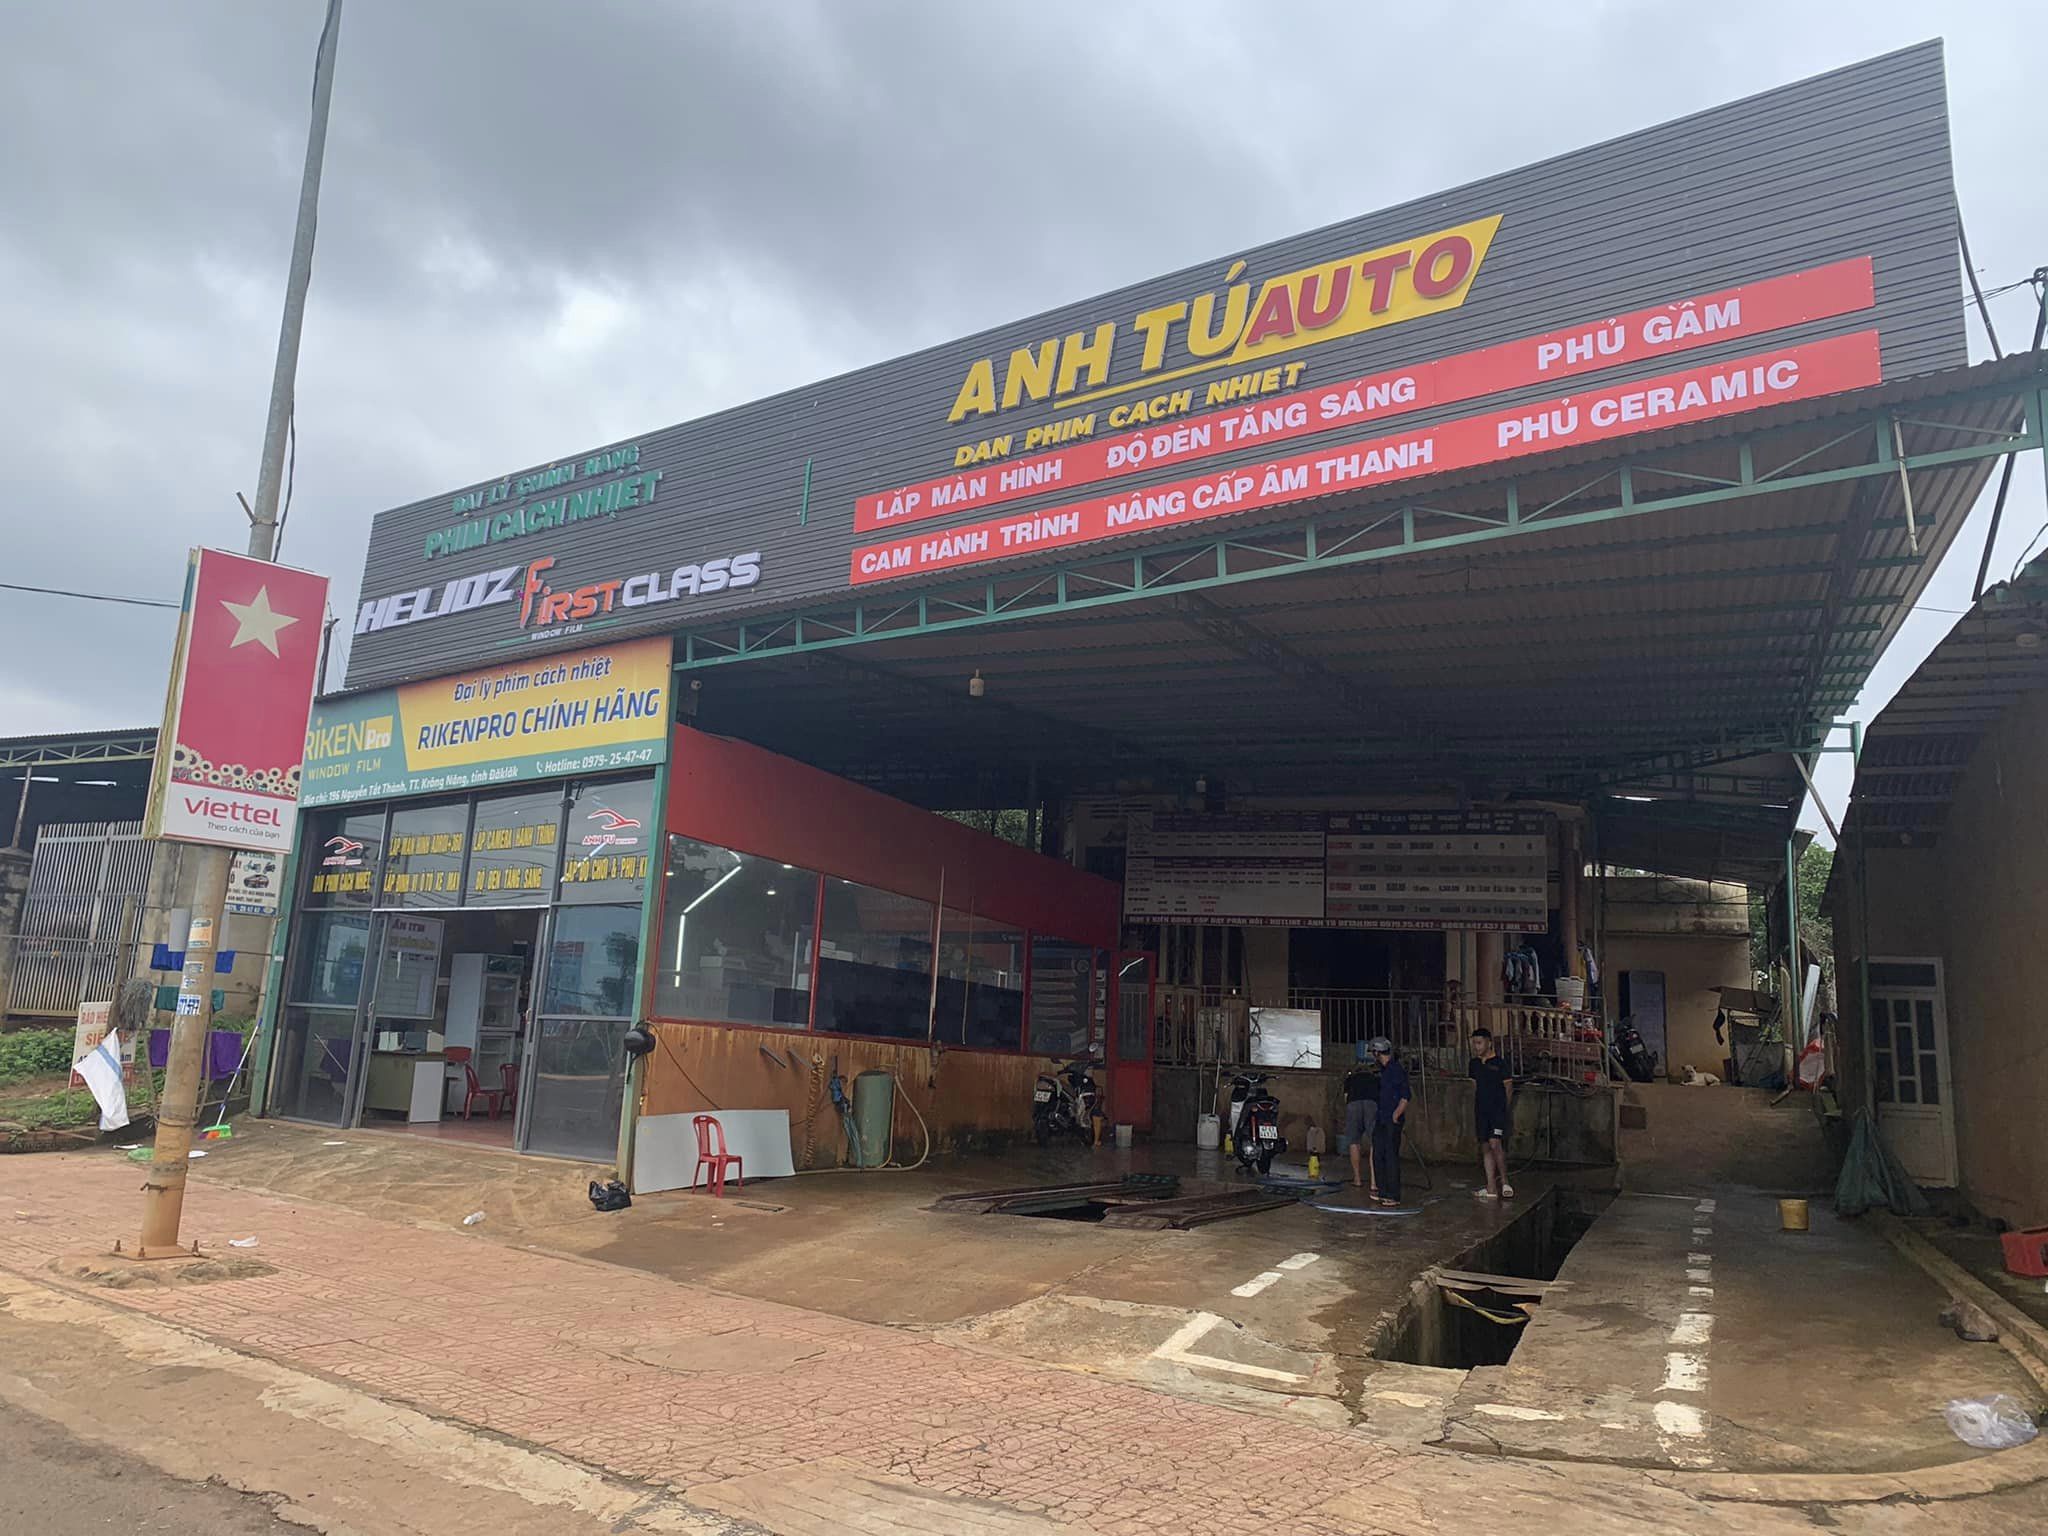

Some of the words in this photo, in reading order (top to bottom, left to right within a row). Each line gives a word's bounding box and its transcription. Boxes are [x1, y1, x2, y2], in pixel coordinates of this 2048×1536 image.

[948, 322, 1116, 422] ANH
[1134, 260, 1250, 372] TÚ
[1245, 235, 1475, 347] AUTO
[876, 487, 921, 520] LẮP
[931, 473, 987, 508] MÀN
[1000, 459, 1063, 493] HÌNH
[1106, 432, 1147, 468] ĐỘ
[1151, 423, 1211, 459] ĐÈN
[1220, 403, 1308, 442] TĂNG
[1320, 377, 1416, 419] SÁNG
[1537, 318, 1625, 370] PHỦ
[1643, 298, 1741, 345] GẦM
[1024, 413, 1097, 449] PHIM
[1108, 390, 1194, 428] CACH
[1206, 361, 1307, 405] NHIET
[861, 545, 911, 574] CAM
[920, 531, 988, 563] HÀNH
[1000, 512, 1079, 545] TRÌNH
[1107, 493, 1186, 526] NÂNG
[1192, 471, 1254, 508] CẤP
[1259, 464, 1308, 497] ÂM
[1315, 439, 1433, 485] THANH
[1497, 399, 1578, 449] PHỦ
[1590, 359, 1799, 427] CERAMIC
[423, 518, 491, 560] PHIM
[569, 466, 663, 520] NHIỆT
[531, 628, 561, 640] WINDOW
[565, 624, 583, 635] FILM
[454, 681, 476, 704] Đại
[478, 680, 491, 701] lý
[493, 674, 529, 699] phim
[533, 664, 567, 687] cách
[571, 656, 612, 683] nhiệt
[417, 711, 517, 750] RIKENPRO
[521, 698, 588, 734] CHÍNH
[593, 688, 660, 723] HÃNG
[308, 762, 350, 780] WINDOW
[356, 757, 382, 773] FILM
[544, 758, 580, 773] Hotline:
[185, 797, 281, 827] viettel
[207, 821, 228, 832] Theo
[229, 825, 248, 834] cách
[249, 827, 264, 836] của
